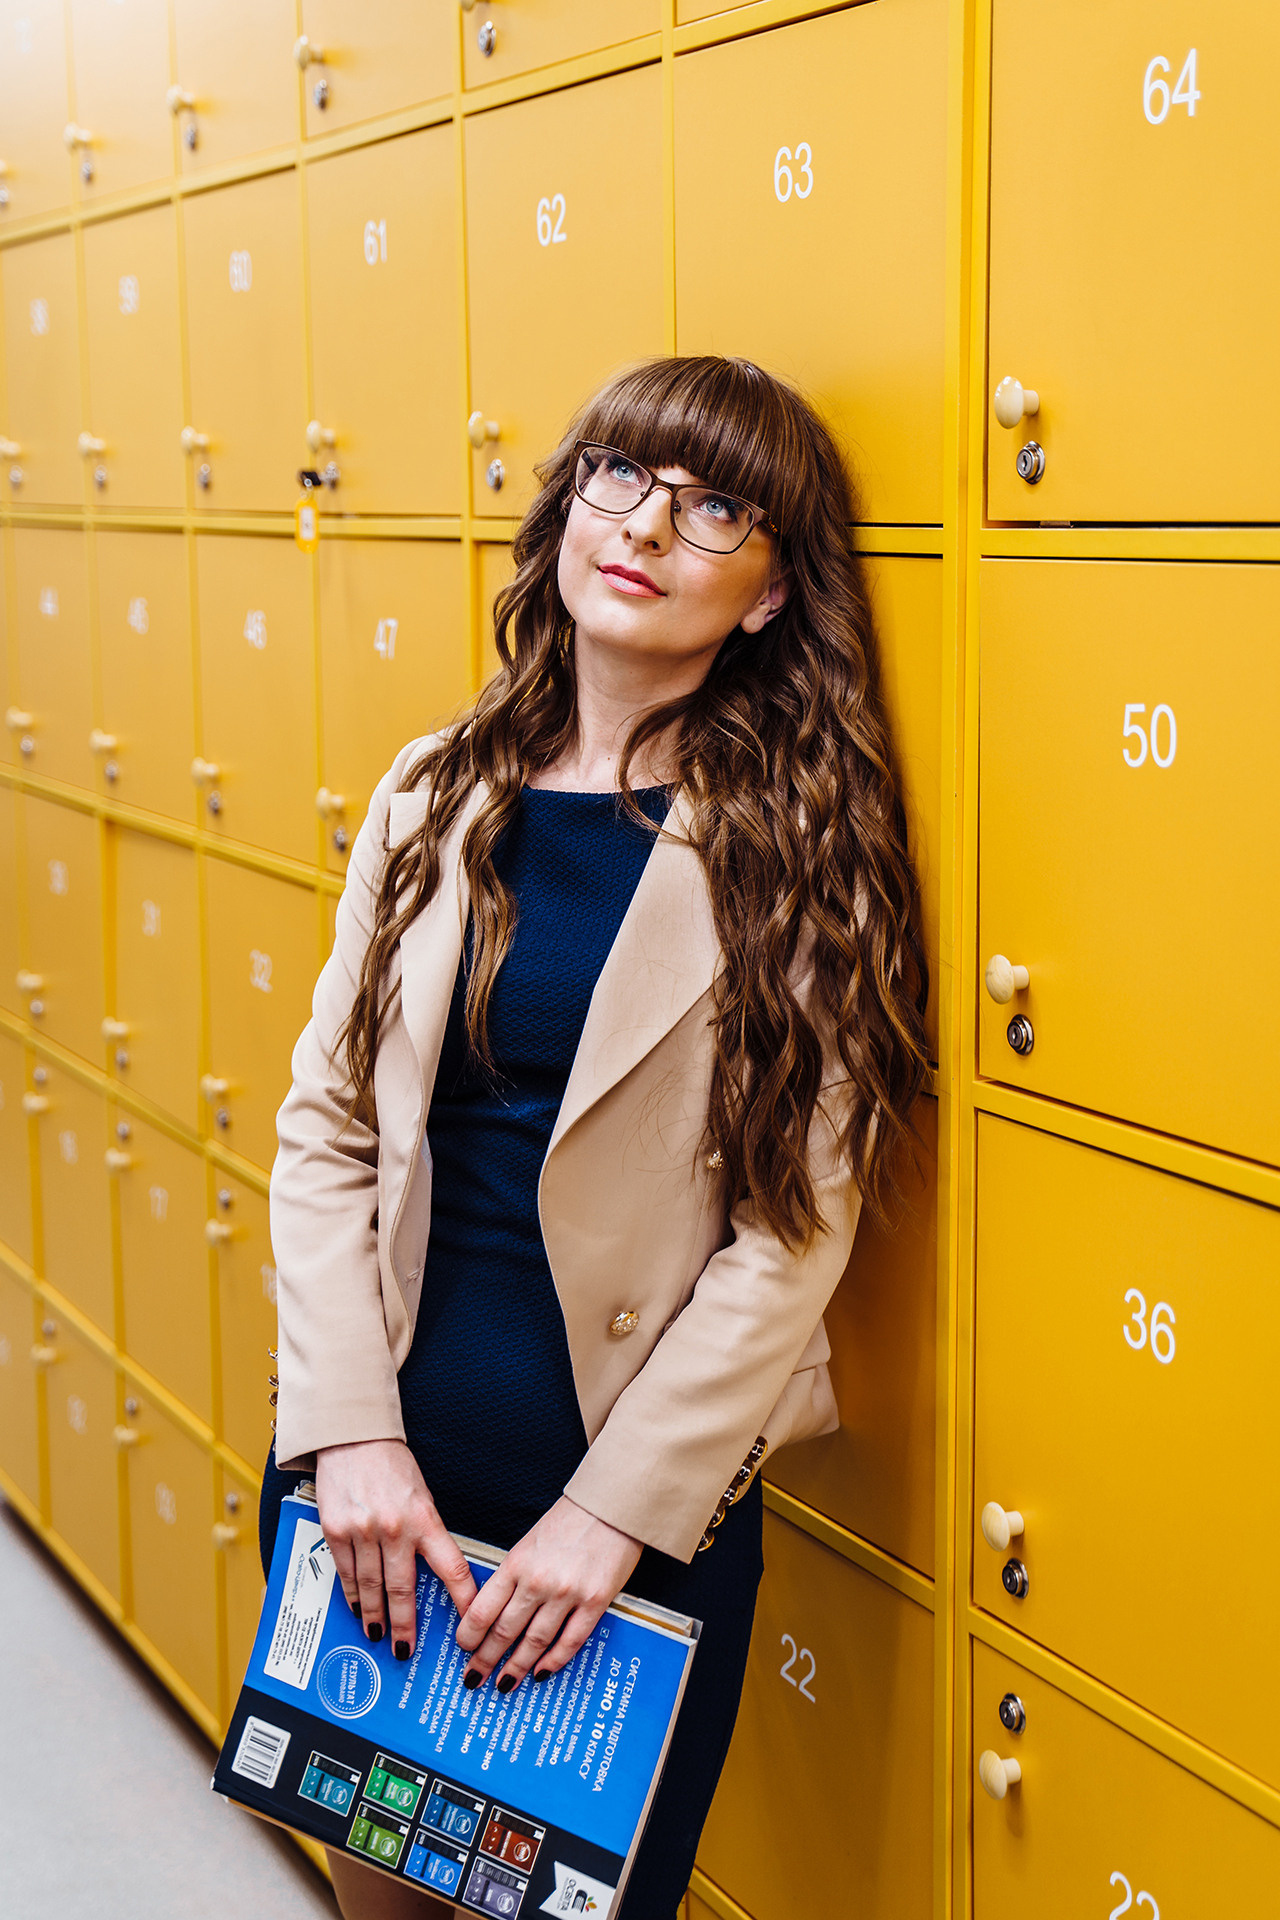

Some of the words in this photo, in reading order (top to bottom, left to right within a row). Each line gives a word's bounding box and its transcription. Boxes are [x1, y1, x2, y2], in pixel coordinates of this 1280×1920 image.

[1142, 47, 1203, 126] 64
[773, 141, 814, 204] 63
[536, 192, 568, 247] 62
[363, 218, 388, 266] 61
[243, 610, 267, 651] 46
[373, 617, 399, 660] 47
[1122, 702, 1178, 769] 50
[1122, 1287, 1177, 1365] 36
[417, 1571, 428, 1584] ТА
[422, 1602, 433, 1618] ДО
[405, 1616, 430, 1682] ТРЕНУВАЛЬНИХ
[426, 1633, 451, 1696] АУДІОЗАПИСИ
[442, 1644, 462, 1686] ЛЕКСИКИ
[606, 1656, 622, 1678] ДО
[779, 1633, 817, 1704] 22
[345, 1658, 358, 1705] РЕЗУЛЬТАТ
[396, 1680, 413, 1710] ВПРАВ
[439, 1684, 449, 1697] ТА
[548, 1669, 571, 1725] ВИКОНАННЯ
[584, 1676, 595, 1693] ДО
[598, 1676, 619, 1713] ЗНО
[614, 1655, 642, 1721] СИСТЕМНА
[426, 1695, 446, 1736] ПИСЬМА
[466, 1691, 485, 1734] ФОРМАТІ
[481, 1712, 492, 1727] ТА
[531, 1711, 545, 1734] ЗНО
[575, 1691, 591, 1723] ЗНАНЬ
[433, 1707, 455, 1754] МАТЕРІАЛ
[459, 1731, 473, 1755] ЗНО
[486, 1707, 507, 1751] ФОРМАТІ
[508, 1721, 529, 1765] ЗАВДАНЬ
[533, 1723, 555, 1769] ТИПОВИХ
[562, 1733, 578, 1764] ВМІНЬ
[571, 1721, 582, 1736] ТА
[589, 1719, 606, 1741] 10
[479, 1748, 494, 1772] ЗНО
[548, 1743, 562, 1766] ЗНО
[576, 1738, 598, 1780] КЛАСУ
[591, 1719, 623, 1794] ПІДГОТОВКА
